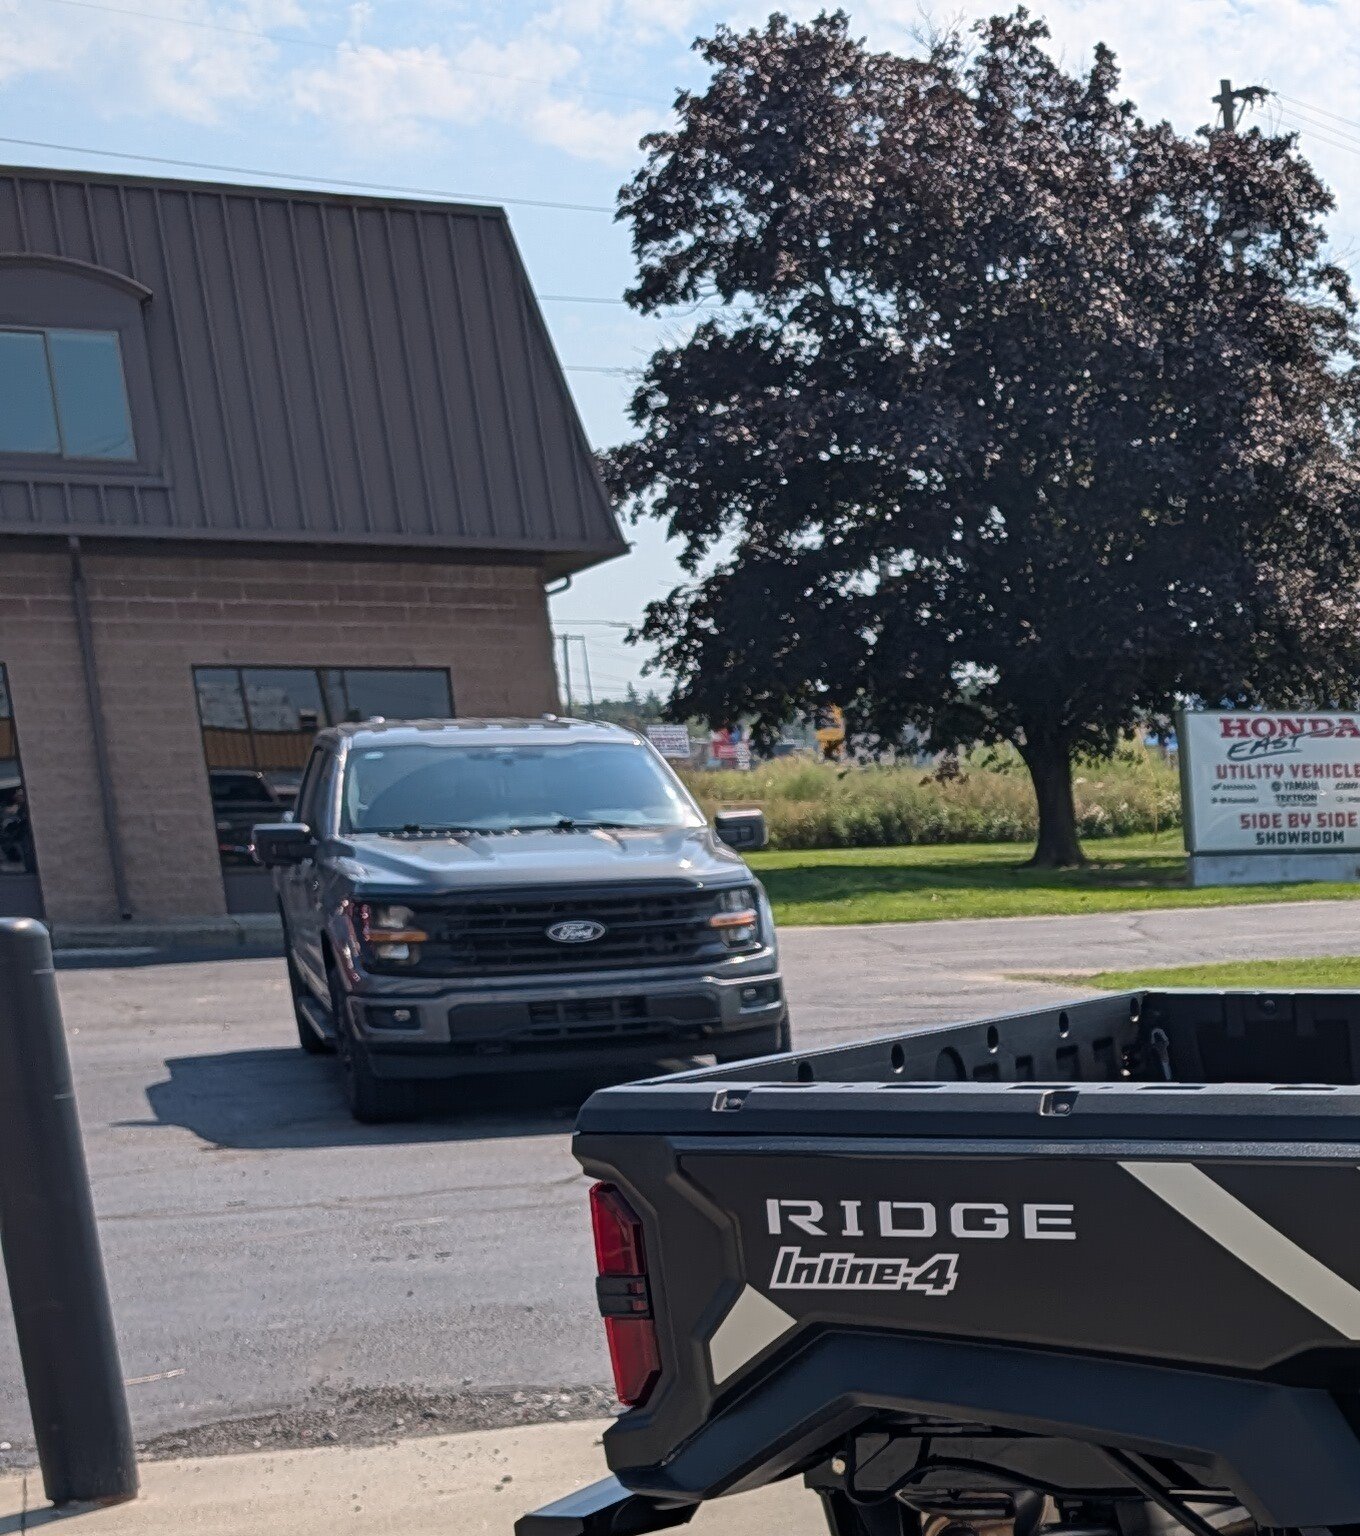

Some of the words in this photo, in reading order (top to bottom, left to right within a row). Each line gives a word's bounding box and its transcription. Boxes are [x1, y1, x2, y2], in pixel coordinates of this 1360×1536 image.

[1216, 764, 1284, 779] UTILITY
[1241, 814, 1281, 829] SIDE
[1288, 813, 1311, 828] BY
[1317, 811, 1358, 827] SIDE
[1256, 831, 1345, 845] SHOWROOM
[766, 1198, 1077, 1240] RIDGE
[769, 1246, 959, 1296] Inline-4
